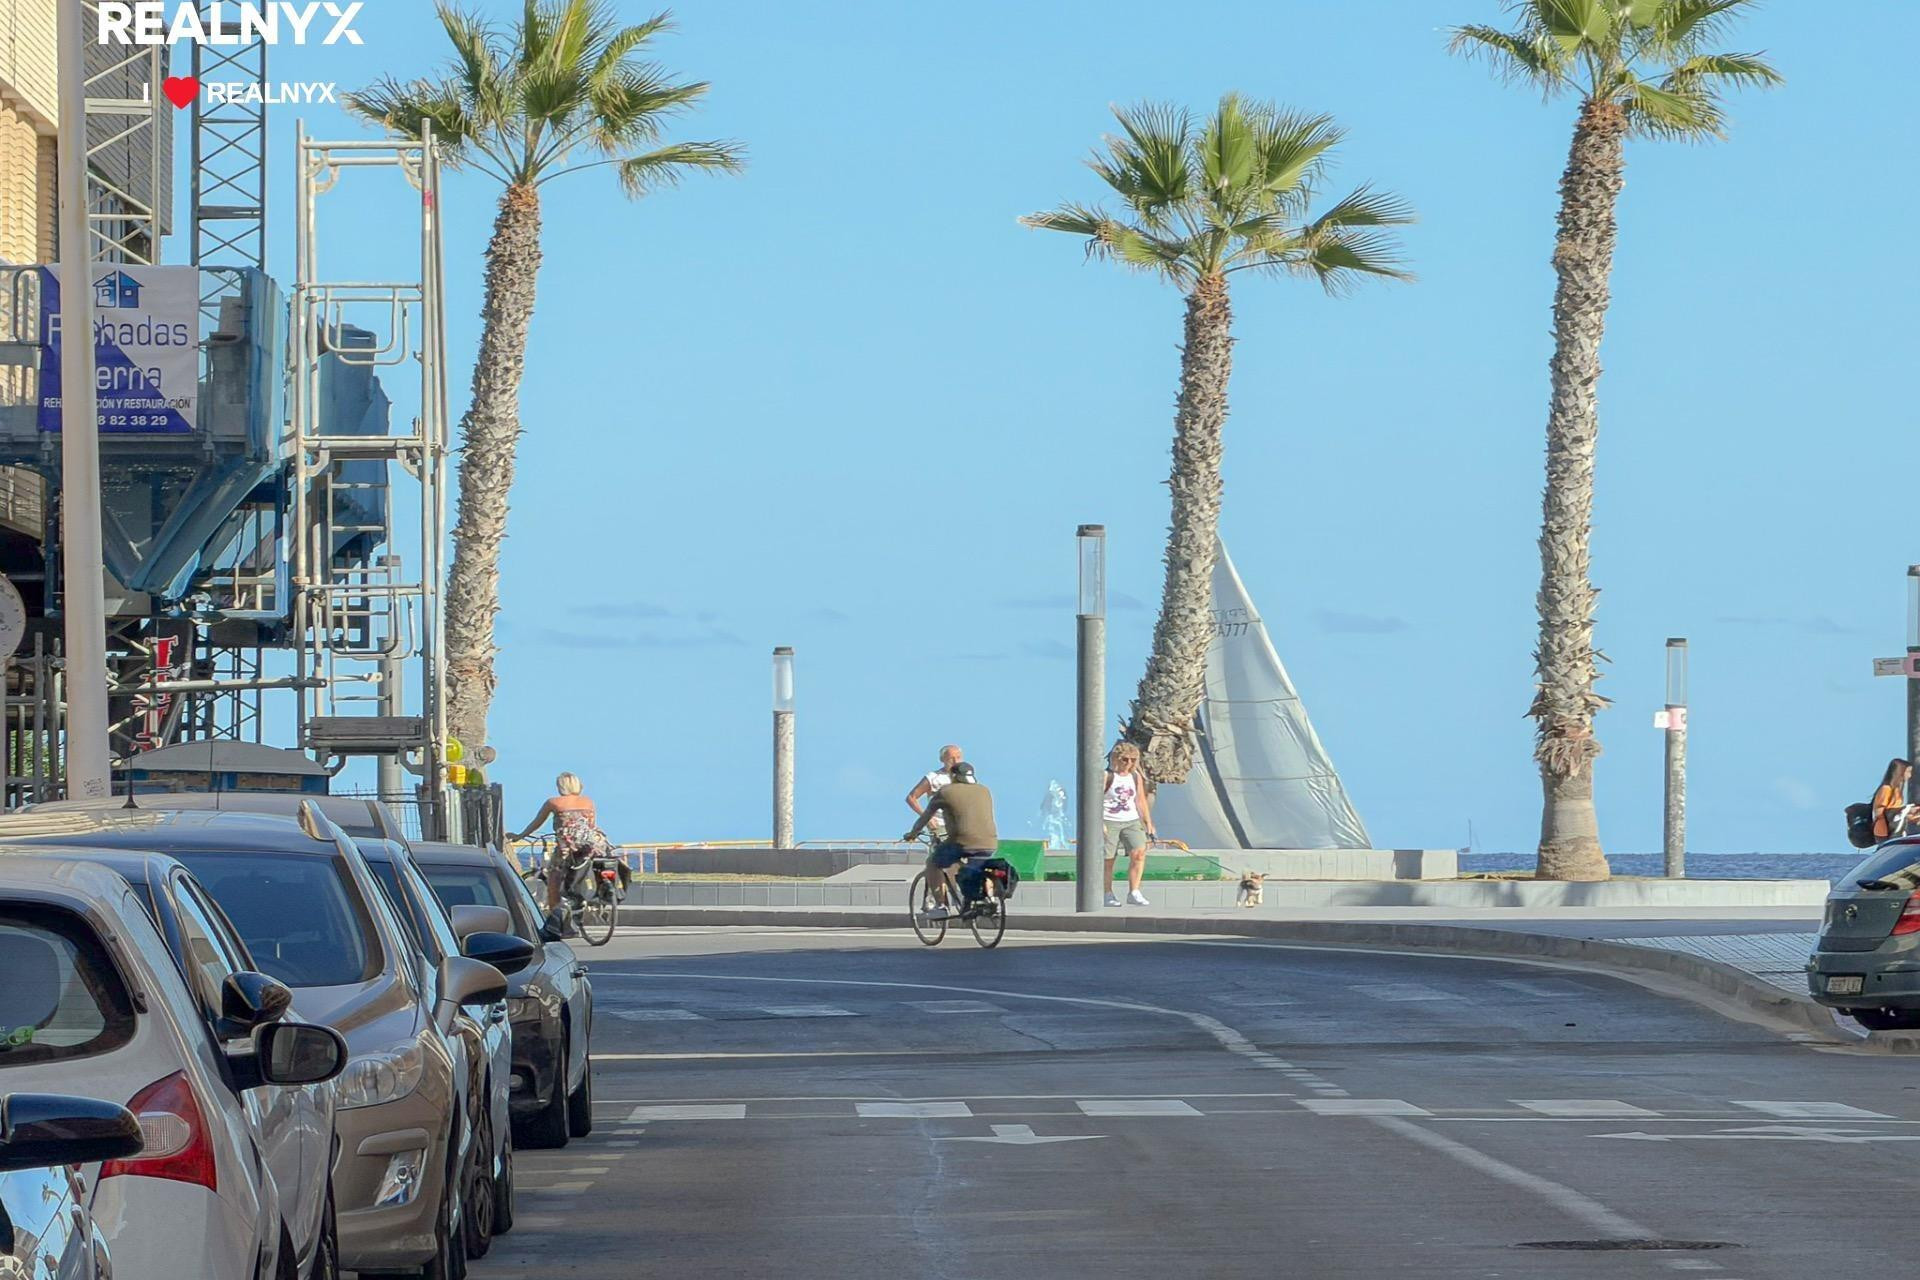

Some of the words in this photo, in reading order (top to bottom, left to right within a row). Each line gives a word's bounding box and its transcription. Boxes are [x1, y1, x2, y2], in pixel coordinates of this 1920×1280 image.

[96, 366, 161, 390] erna
[116, 398, 123, 409] Y
[124, 397, 190, 409] RESTAURACIÓN
[109, 415, 127, 426] 82
[130, 415, 147, 426] 38
[150, 415, 168, 426] 29
[1216, 622, 1248, 637] A777
